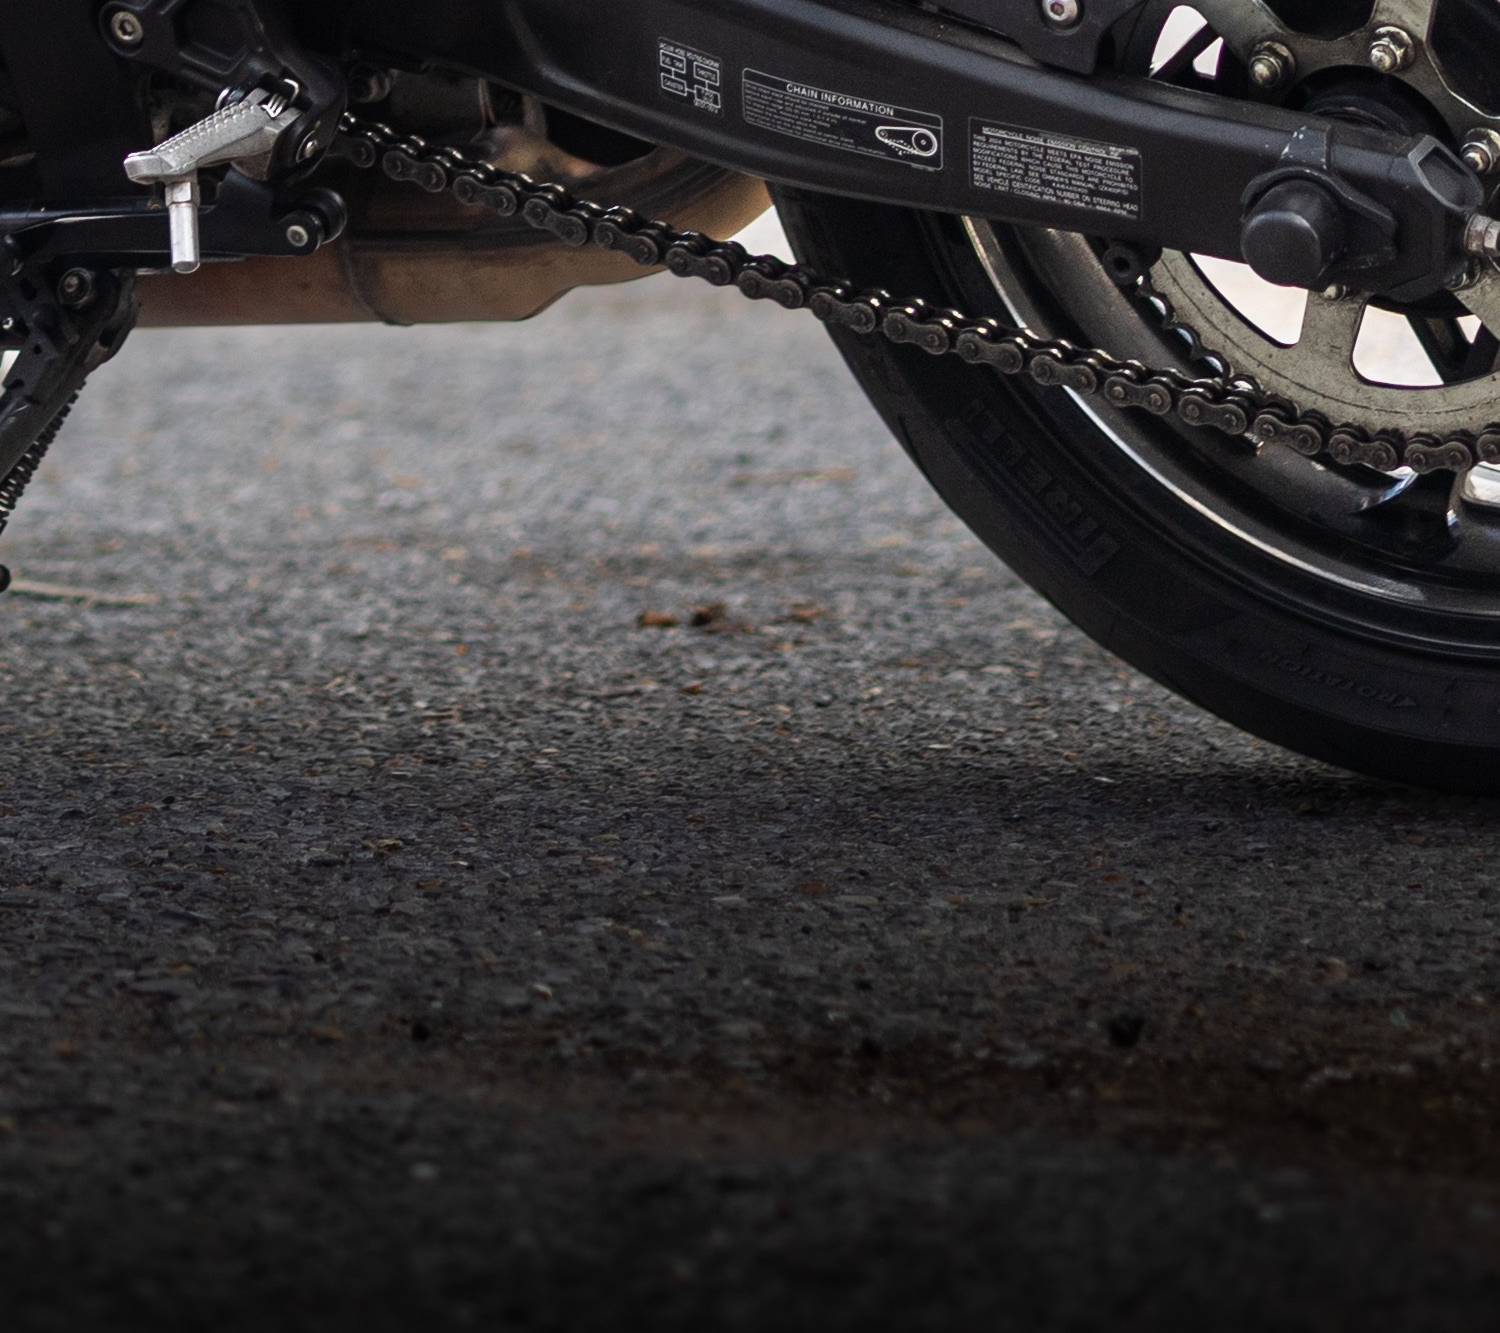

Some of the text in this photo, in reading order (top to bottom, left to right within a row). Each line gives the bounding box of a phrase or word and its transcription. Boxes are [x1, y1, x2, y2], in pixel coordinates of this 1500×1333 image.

[786, 83, 817, 99] CHAIN
[821, 92, 894, 116] INFORMATION
[1257, 646, 1400, 705] ROTATION
